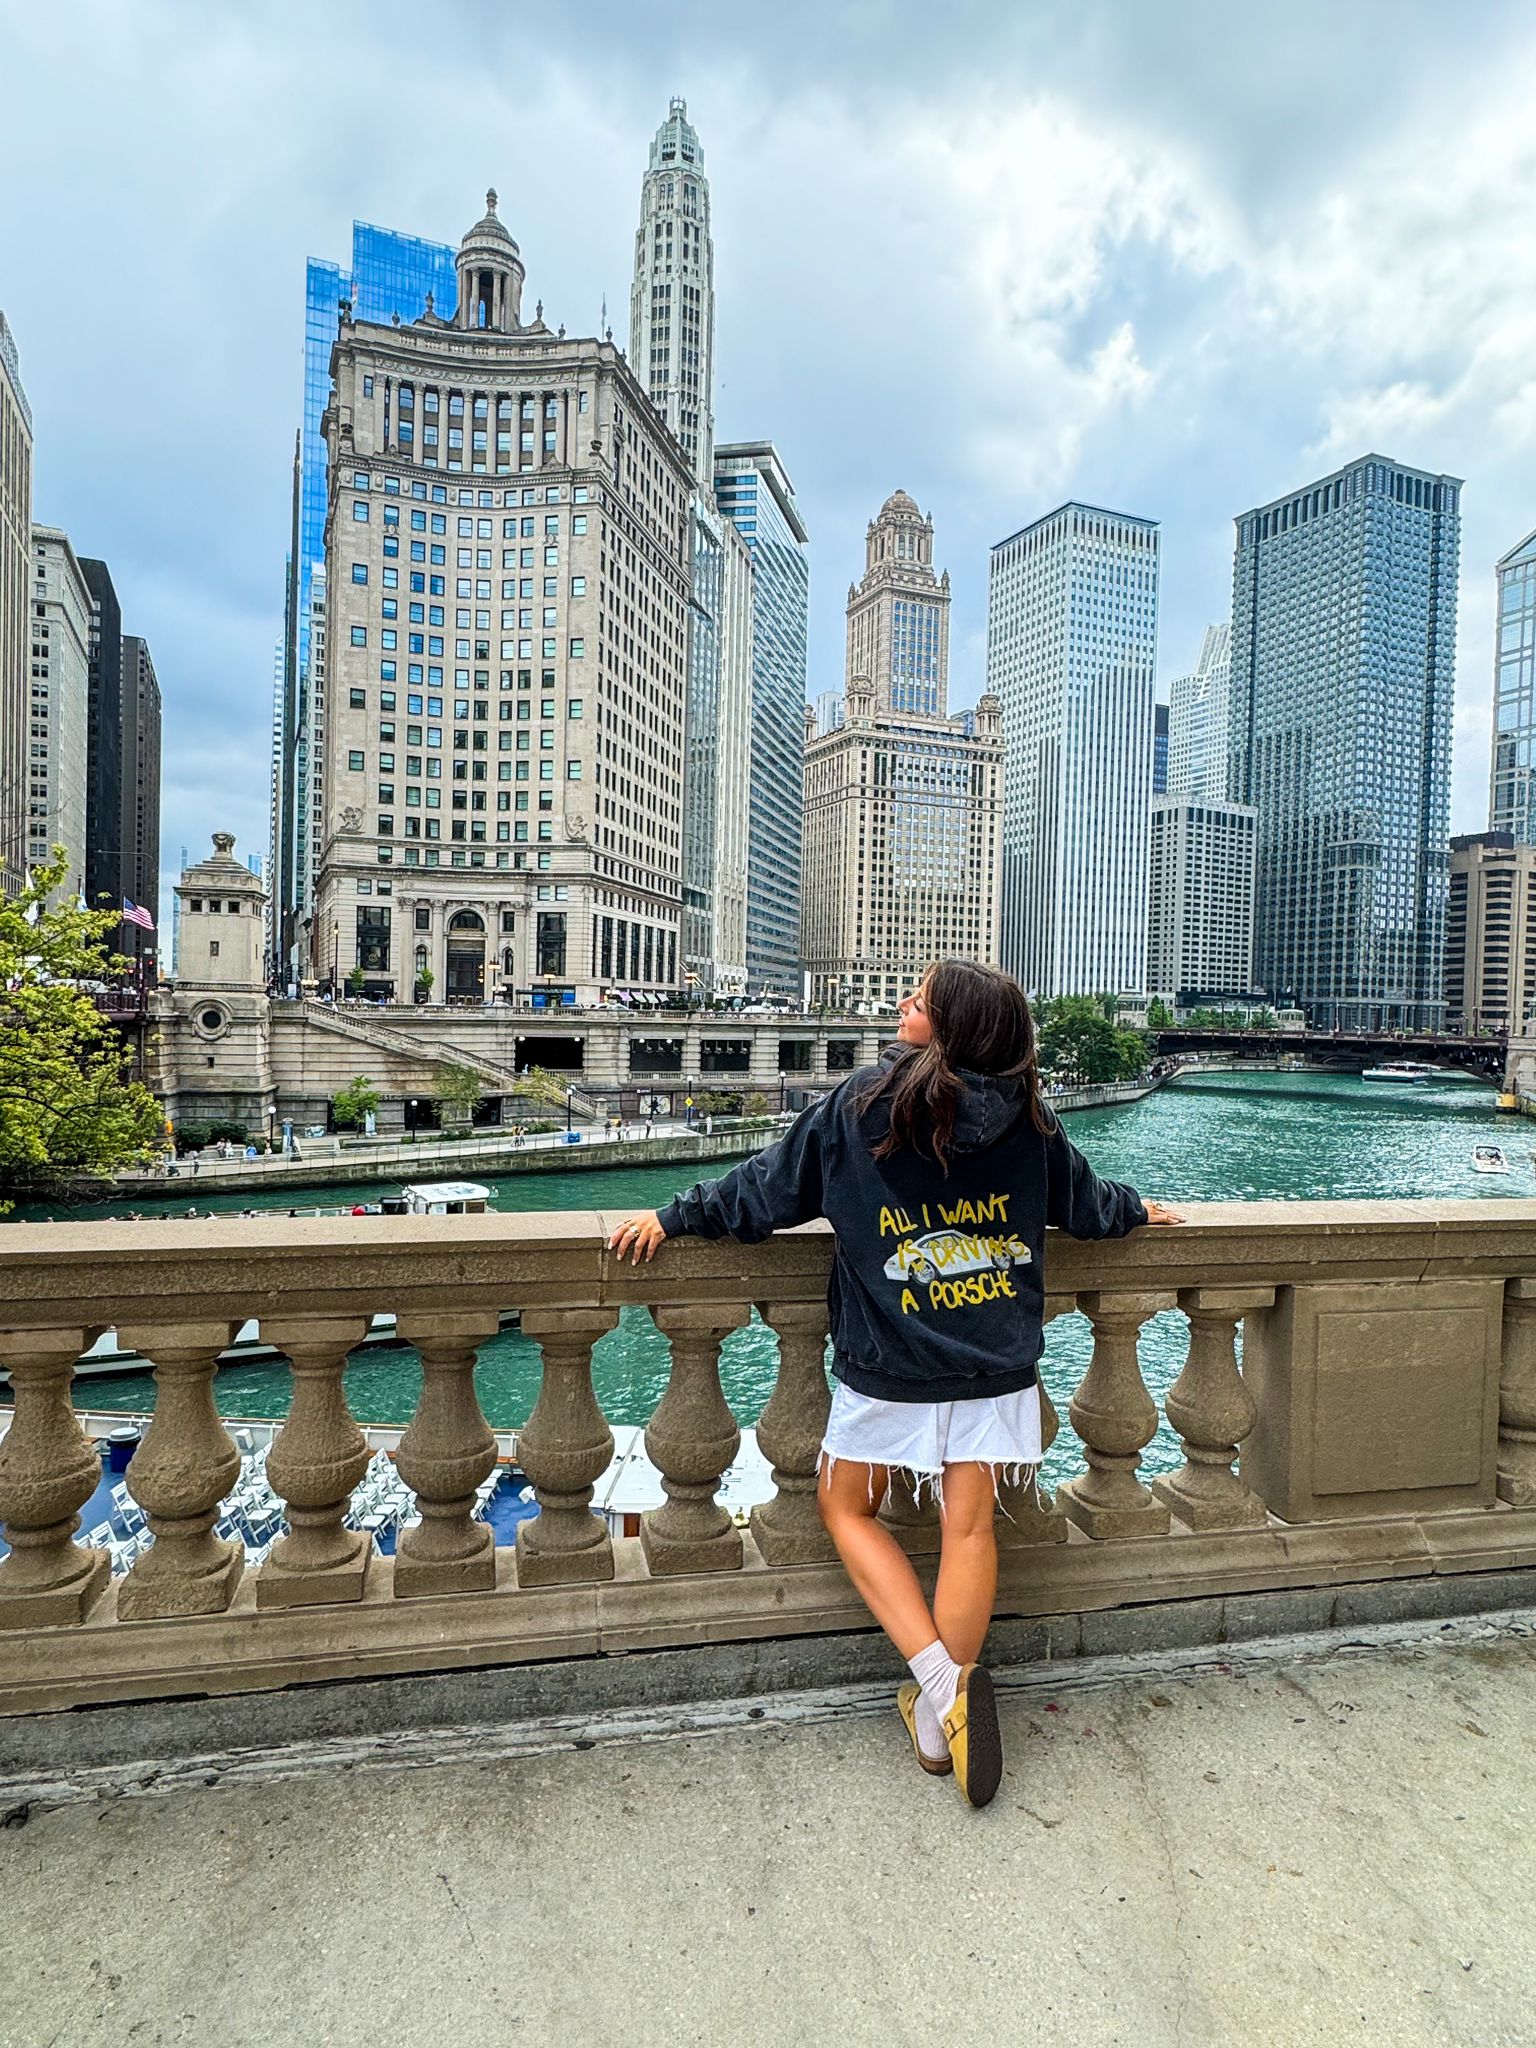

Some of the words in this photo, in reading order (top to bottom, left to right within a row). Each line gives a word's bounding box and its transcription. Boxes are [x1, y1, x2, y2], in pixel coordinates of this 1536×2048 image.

[879, 1205, 918, 1237] ALL
[921, 1203, 931, 1228] I
[937, 1192, 1010, 1225] WANT
[897, 1238, 925, 1272] IS
[930, 1233, 1025, 1268] DRIVING
[901, 1288, 920, 1314] A
[929, 1270, 1017, 1310] PORSCHE
